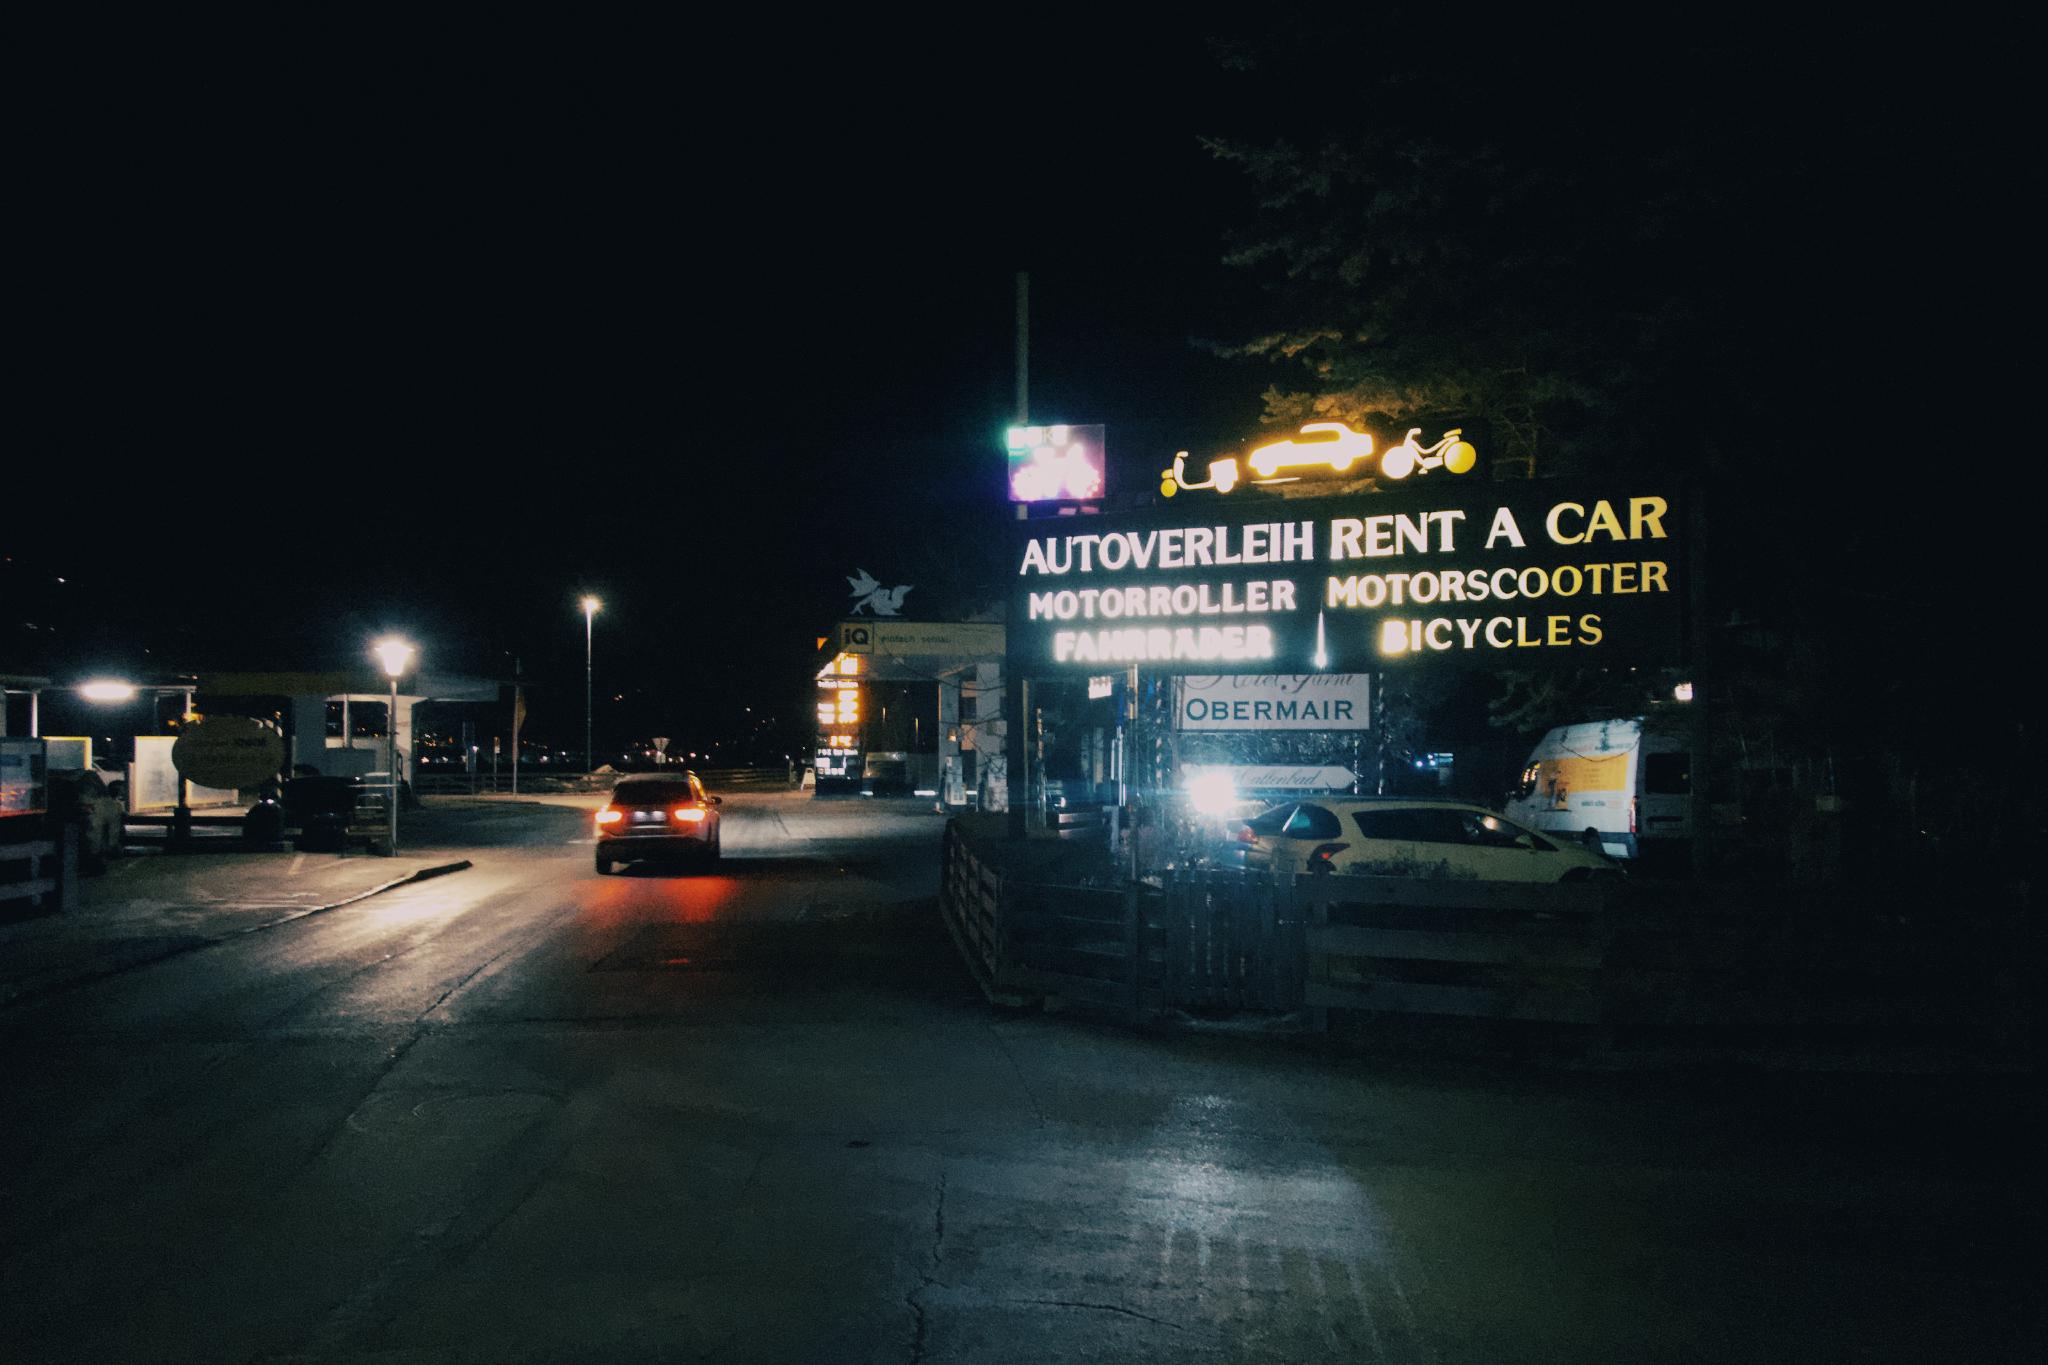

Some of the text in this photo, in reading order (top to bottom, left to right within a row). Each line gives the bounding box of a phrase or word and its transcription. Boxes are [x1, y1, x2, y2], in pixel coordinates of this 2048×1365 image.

[1019, 520, 1314, 576] AUTOVERLEIH
[1329, 496, 1668, 560] RENT A CAR
[1028, 579, 1297, 621] MOTORROLLER
[1327, 560, 1670, 608] MOTORSCOOTER
[1380, 613, 1604, 654] BICYCLES
[1186, 698, 1354, 721] OBERMAIR
